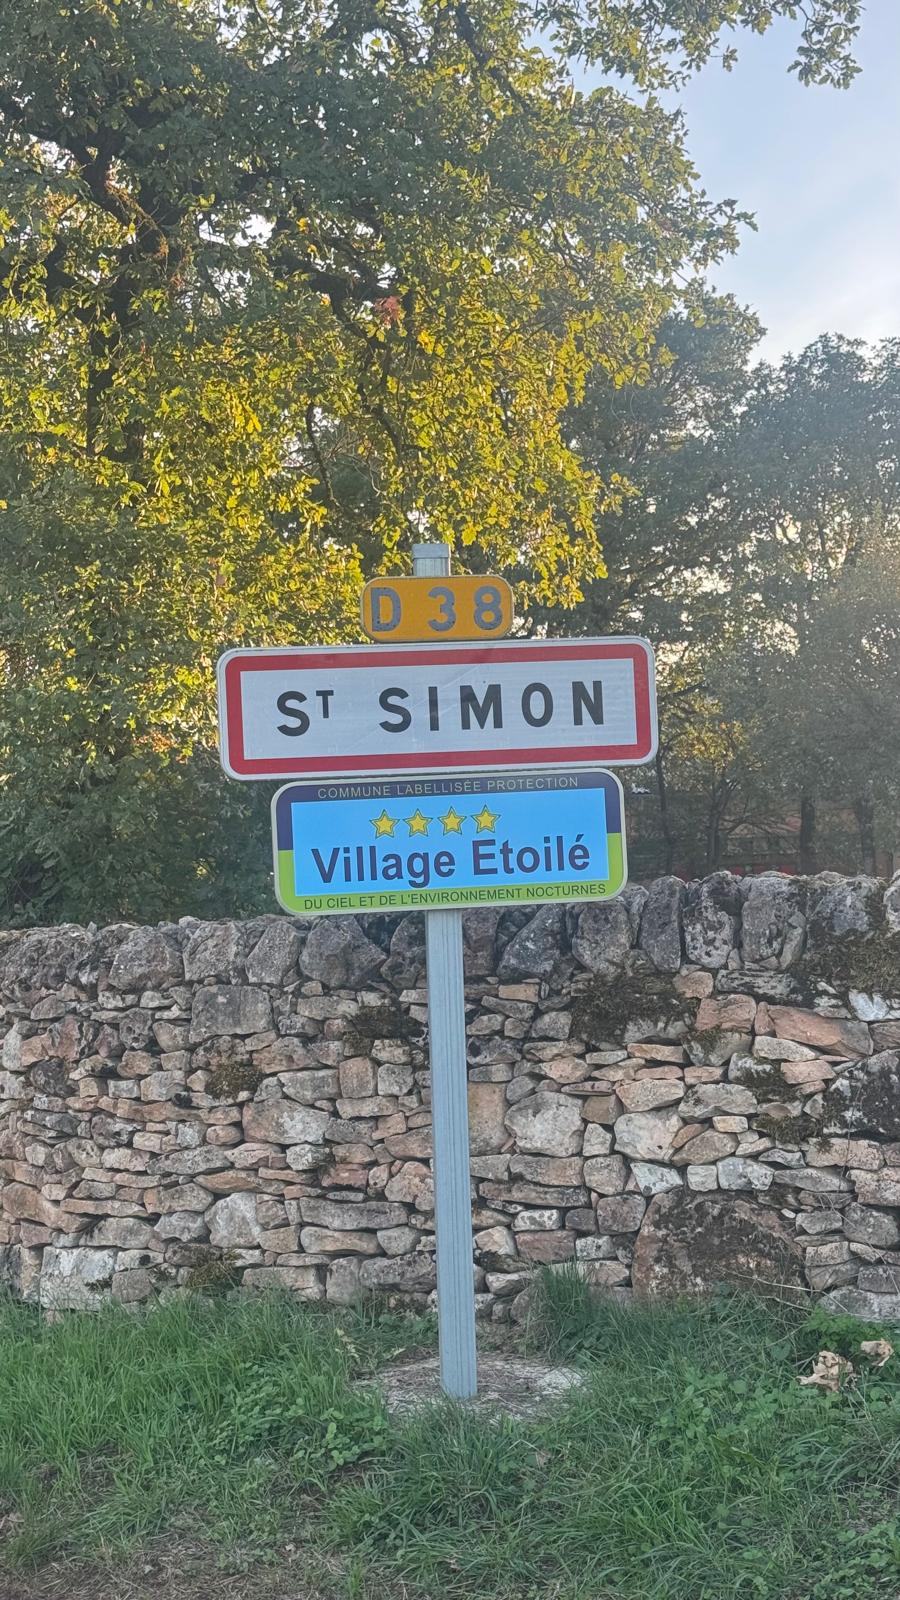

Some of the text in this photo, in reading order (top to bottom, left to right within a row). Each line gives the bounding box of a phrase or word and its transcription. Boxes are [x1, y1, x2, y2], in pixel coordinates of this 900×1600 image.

[371, 585, 503, 632] D 38
[379, 680, 605, 733] SIMON
[317, 776, 578, 799] COMMUNE LABELLISÉE PROTECTION
[310, 834, 590, 889] Village Etoilé
[304, 883, 606, 910] DU CIEL ET DE L'ENVIRONNEMENT NOCTURNES
